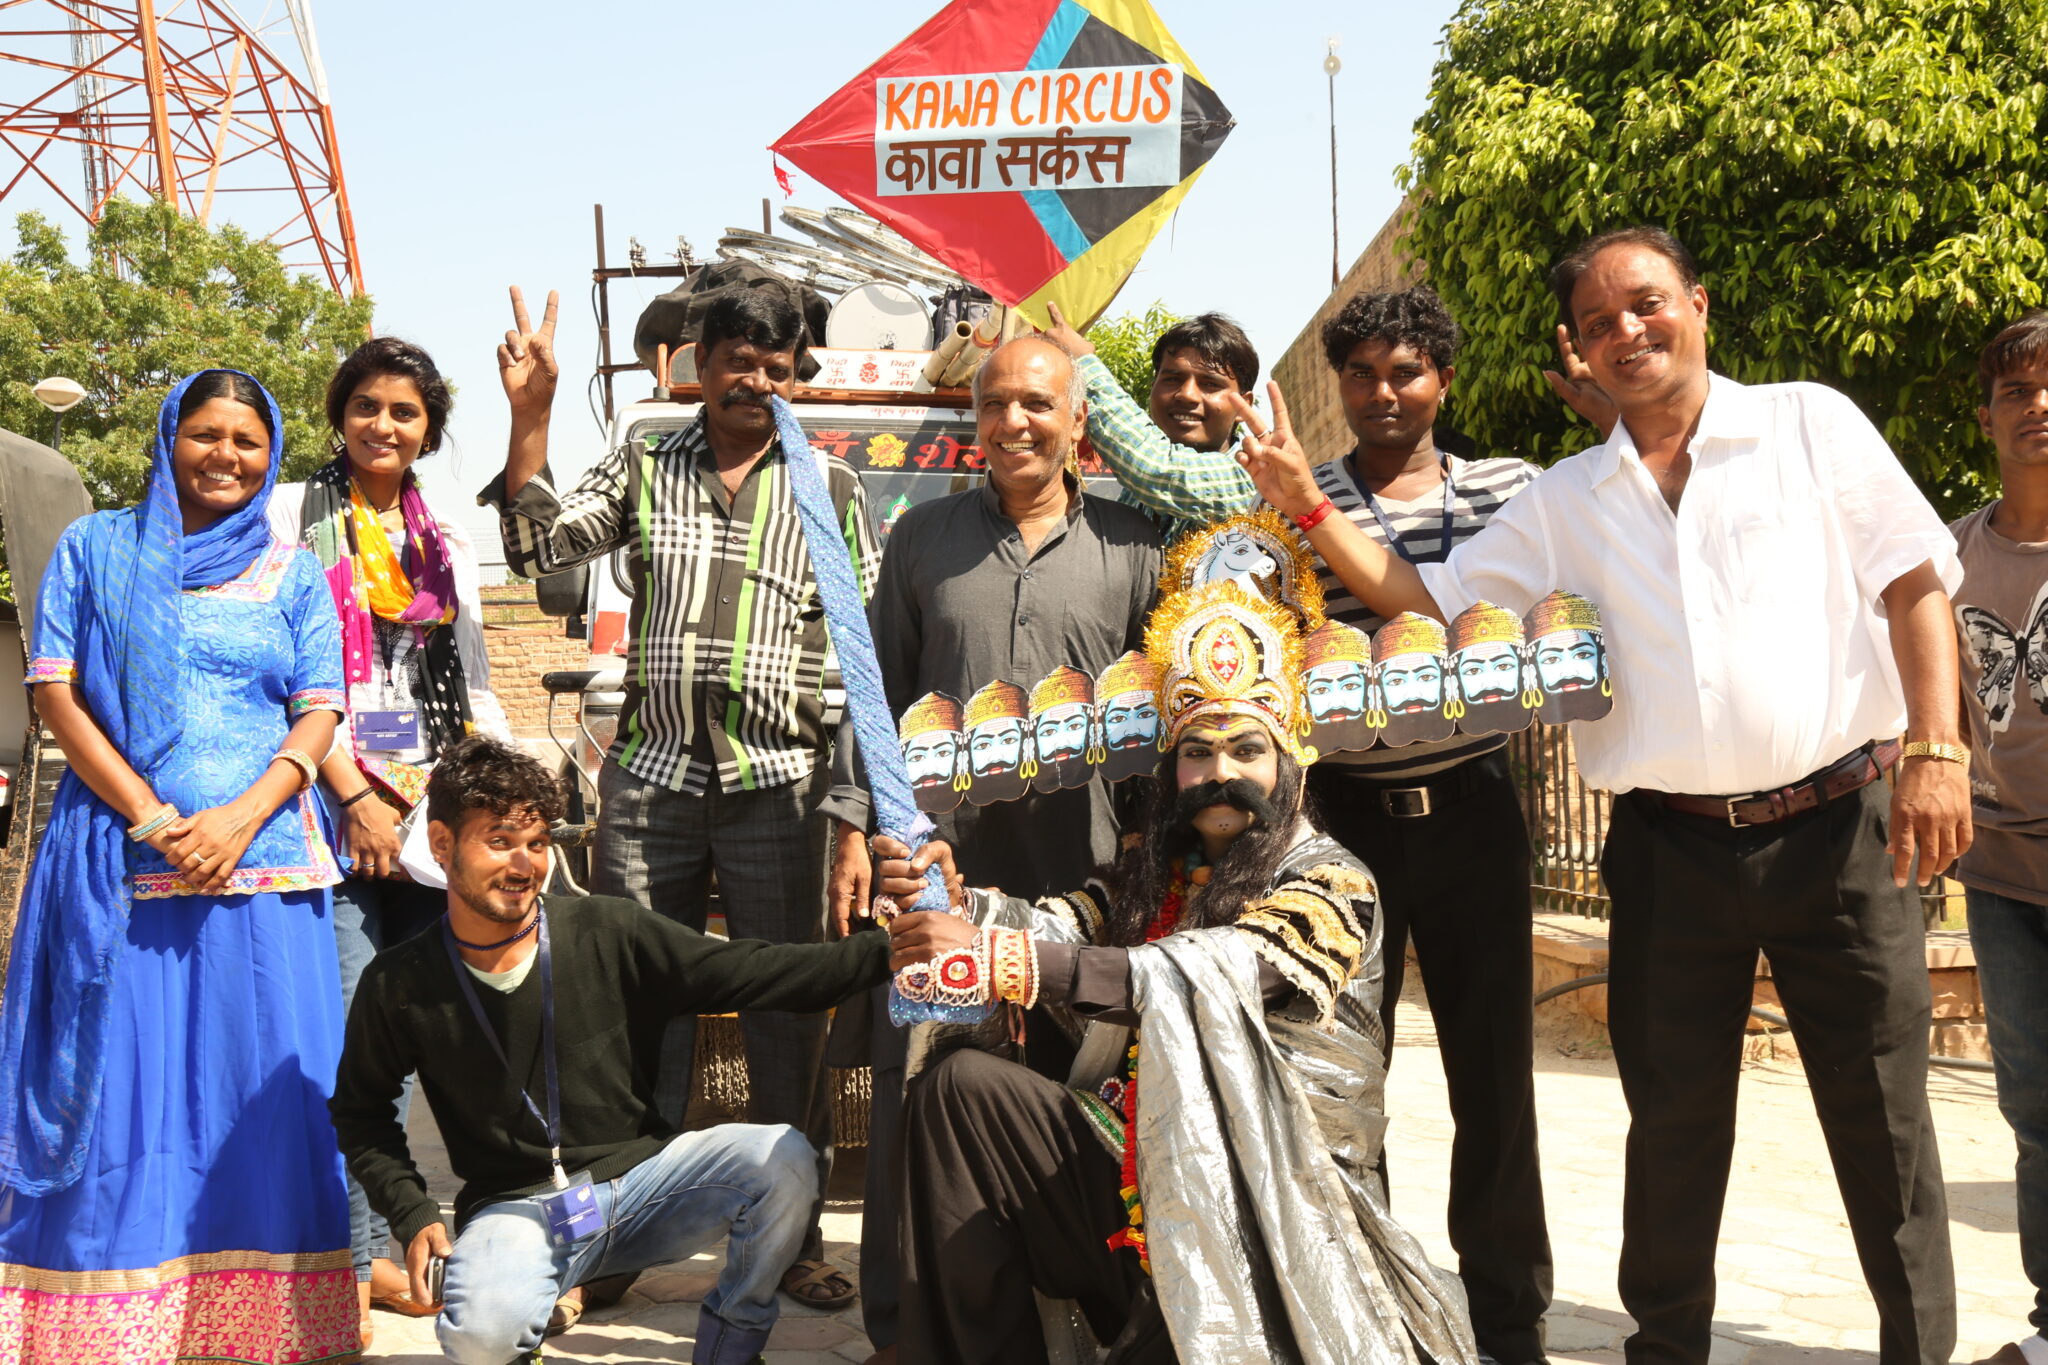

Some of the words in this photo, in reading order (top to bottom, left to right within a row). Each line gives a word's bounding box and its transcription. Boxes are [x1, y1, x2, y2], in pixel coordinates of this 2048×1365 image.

[885, 79, 1000, 131] KAWA
[1010, 67, 1174, 126] CIRCUS
[885, 138, 987, 192] कावा
[995, 126, 1132, 187] सर्कस
